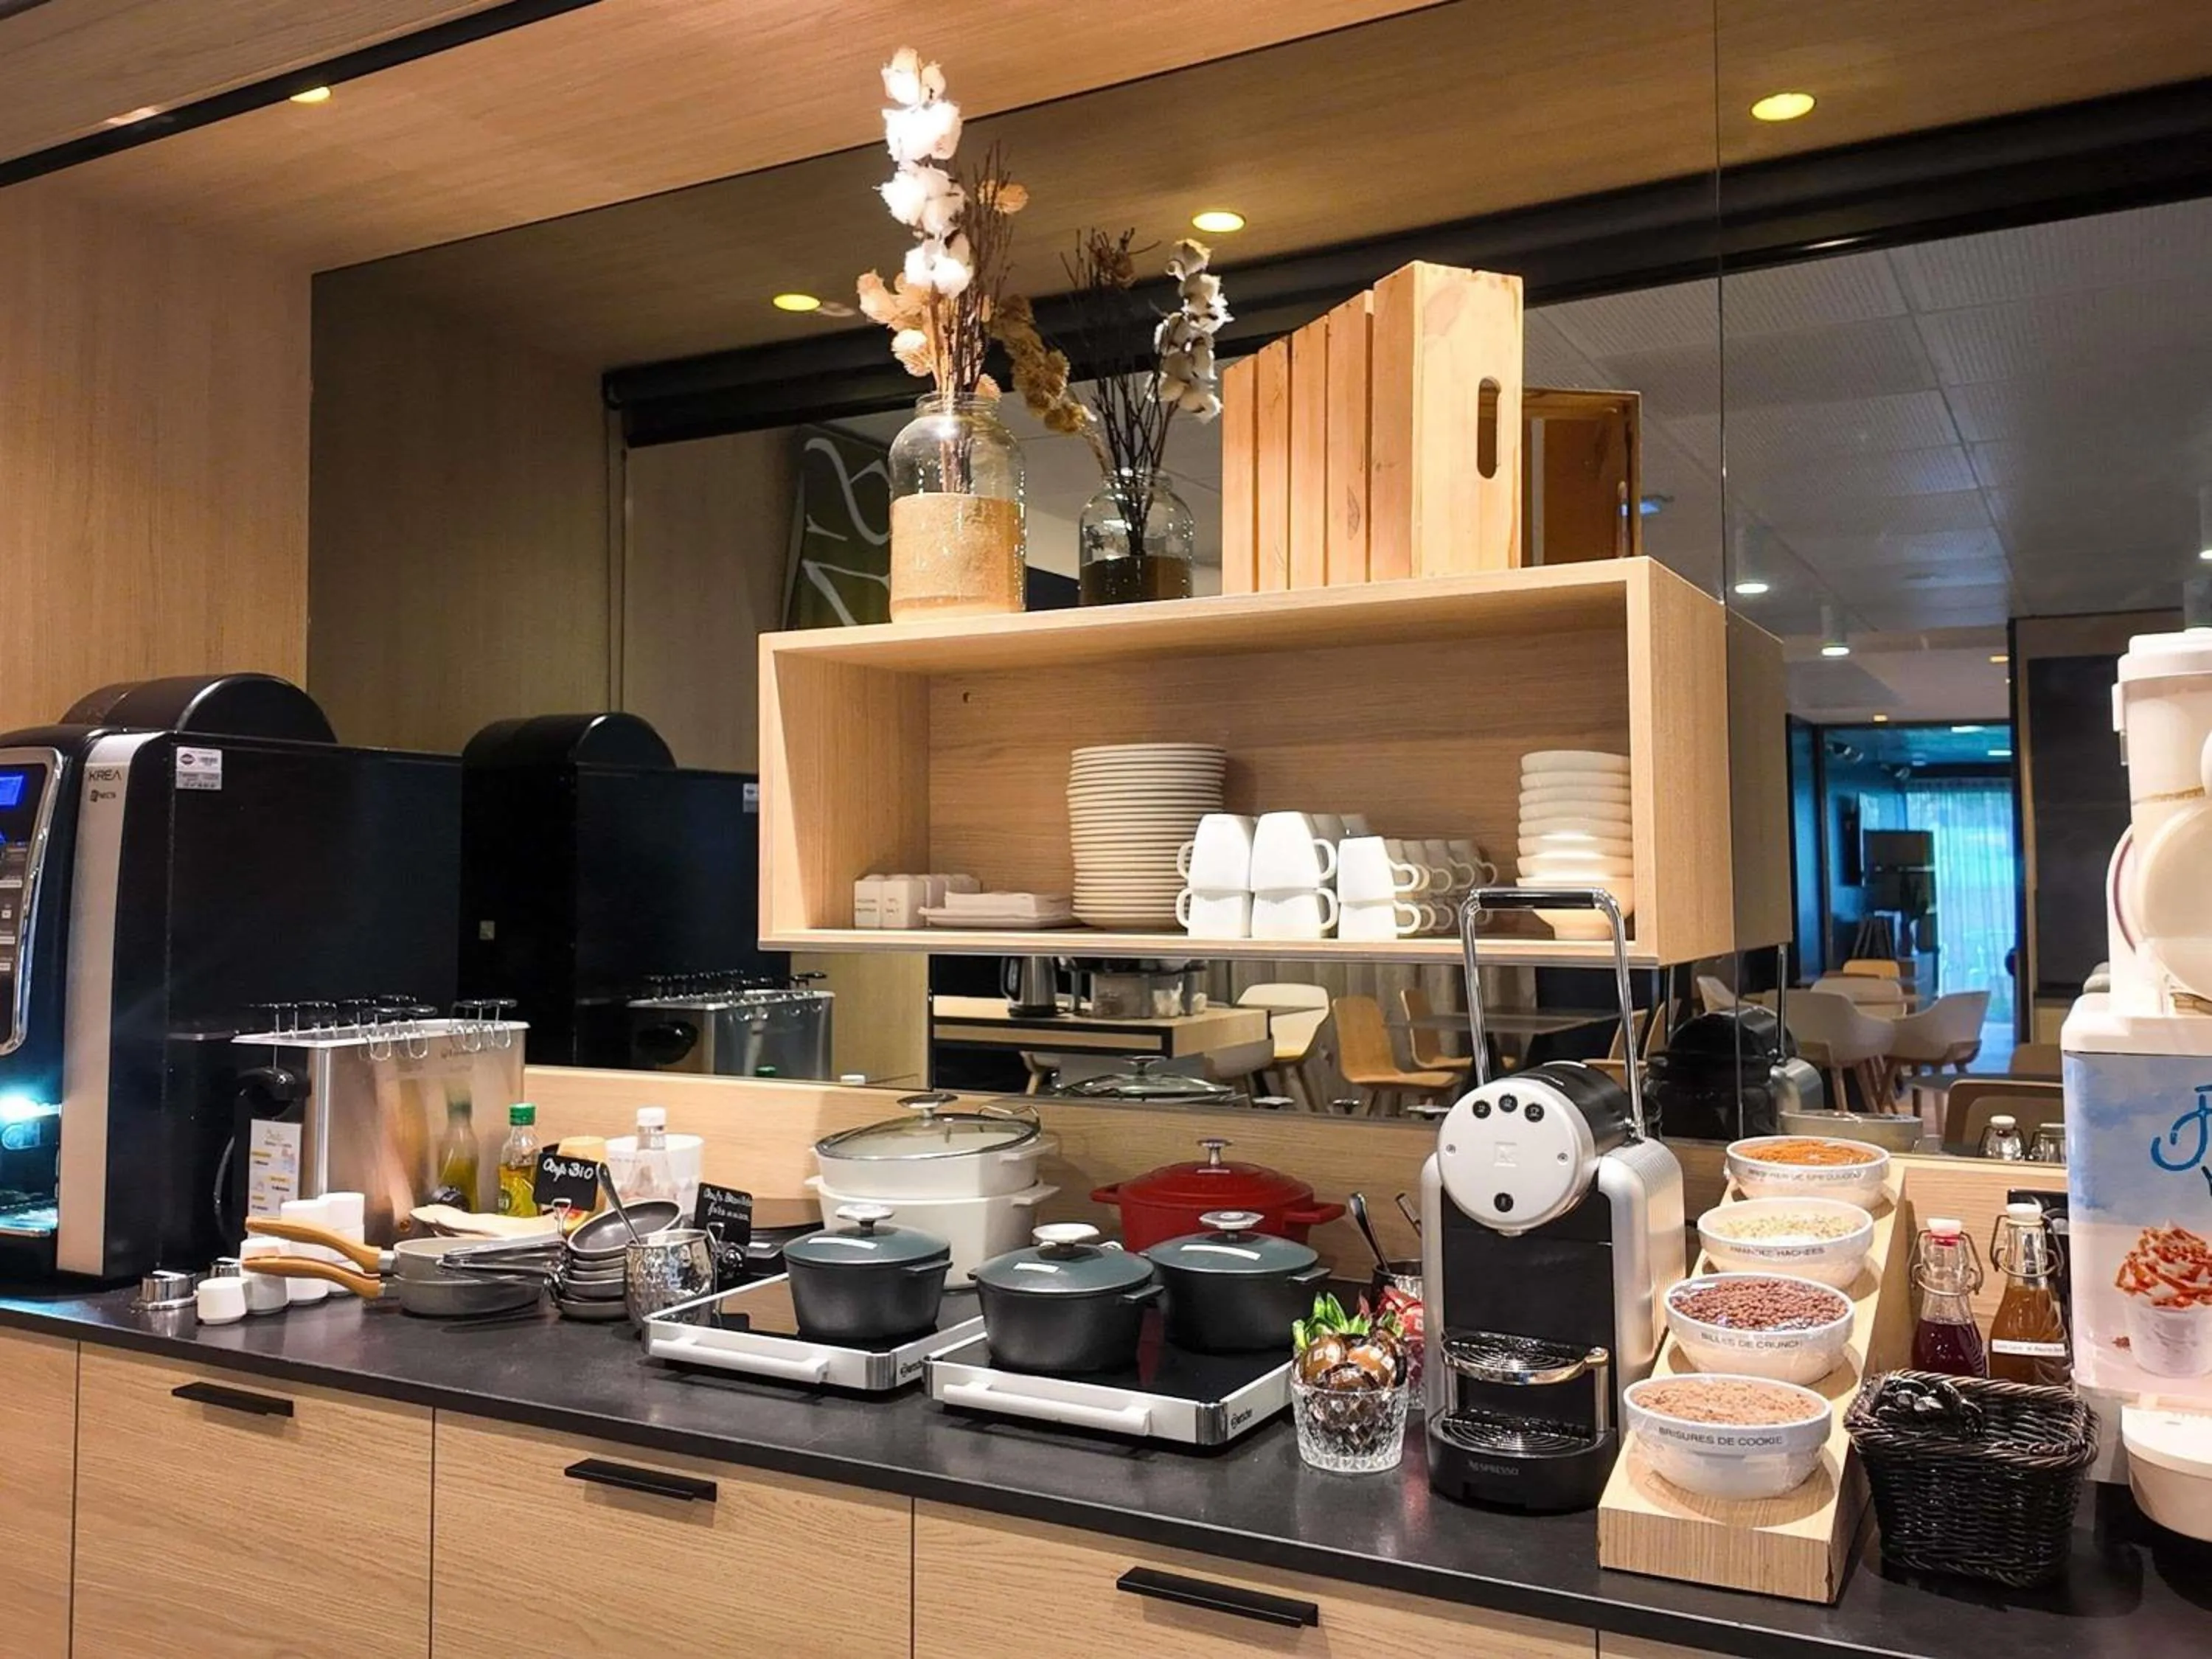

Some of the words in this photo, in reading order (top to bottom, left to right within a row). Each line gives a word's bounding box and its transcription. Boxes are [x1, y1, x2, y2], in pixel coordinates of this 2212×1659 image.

[1737, 1340, 1753, 1349] DE
[1756, 1339, 1804, 1349] CRUNCH
[1658, 1426, 1715, 1445] BRISURES
[1717, 1436, 1734, 1446] DE
[1737, 1436, 1783, 1447] COOKIE
[1467, 1459, 1519, 1475] NESPRESSO
